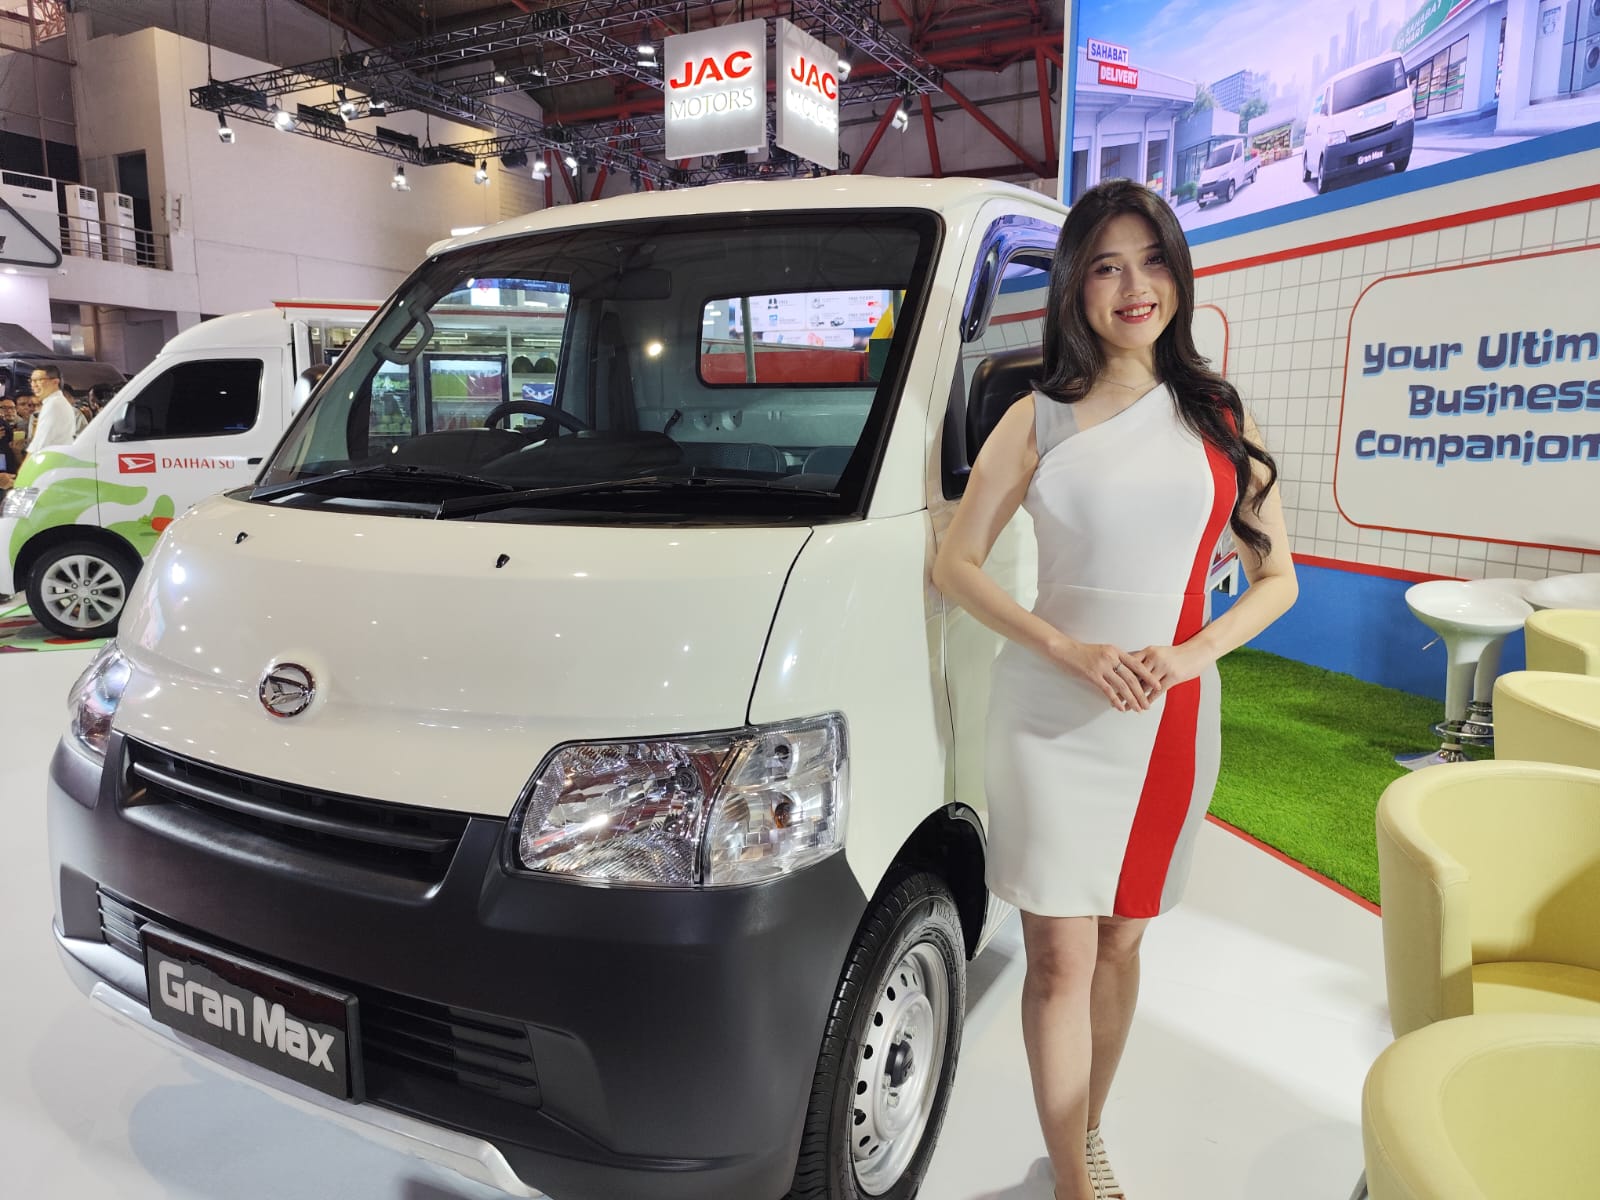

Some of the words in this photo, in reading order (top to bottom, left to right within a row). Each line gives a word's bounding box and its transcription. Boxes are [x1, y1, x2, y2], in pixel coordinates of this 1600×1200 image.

[670, 51, 752, 89] JAC
[1091, 43, 1127, 62] SAHABAT
[791, 57, 837, 100] JAC
[1100, 65, 1138, 85] DELIVERY
[669, 88, 753, 120] MOTORS
[1477, 328, 1600, 371] Ultim
[1408, 380, 1600, 418] Business
[162, 457, 235, 469] DAIHATSU
[159, 960, 246, 1037] Gran
[253, 995, 335, 1073] Max
